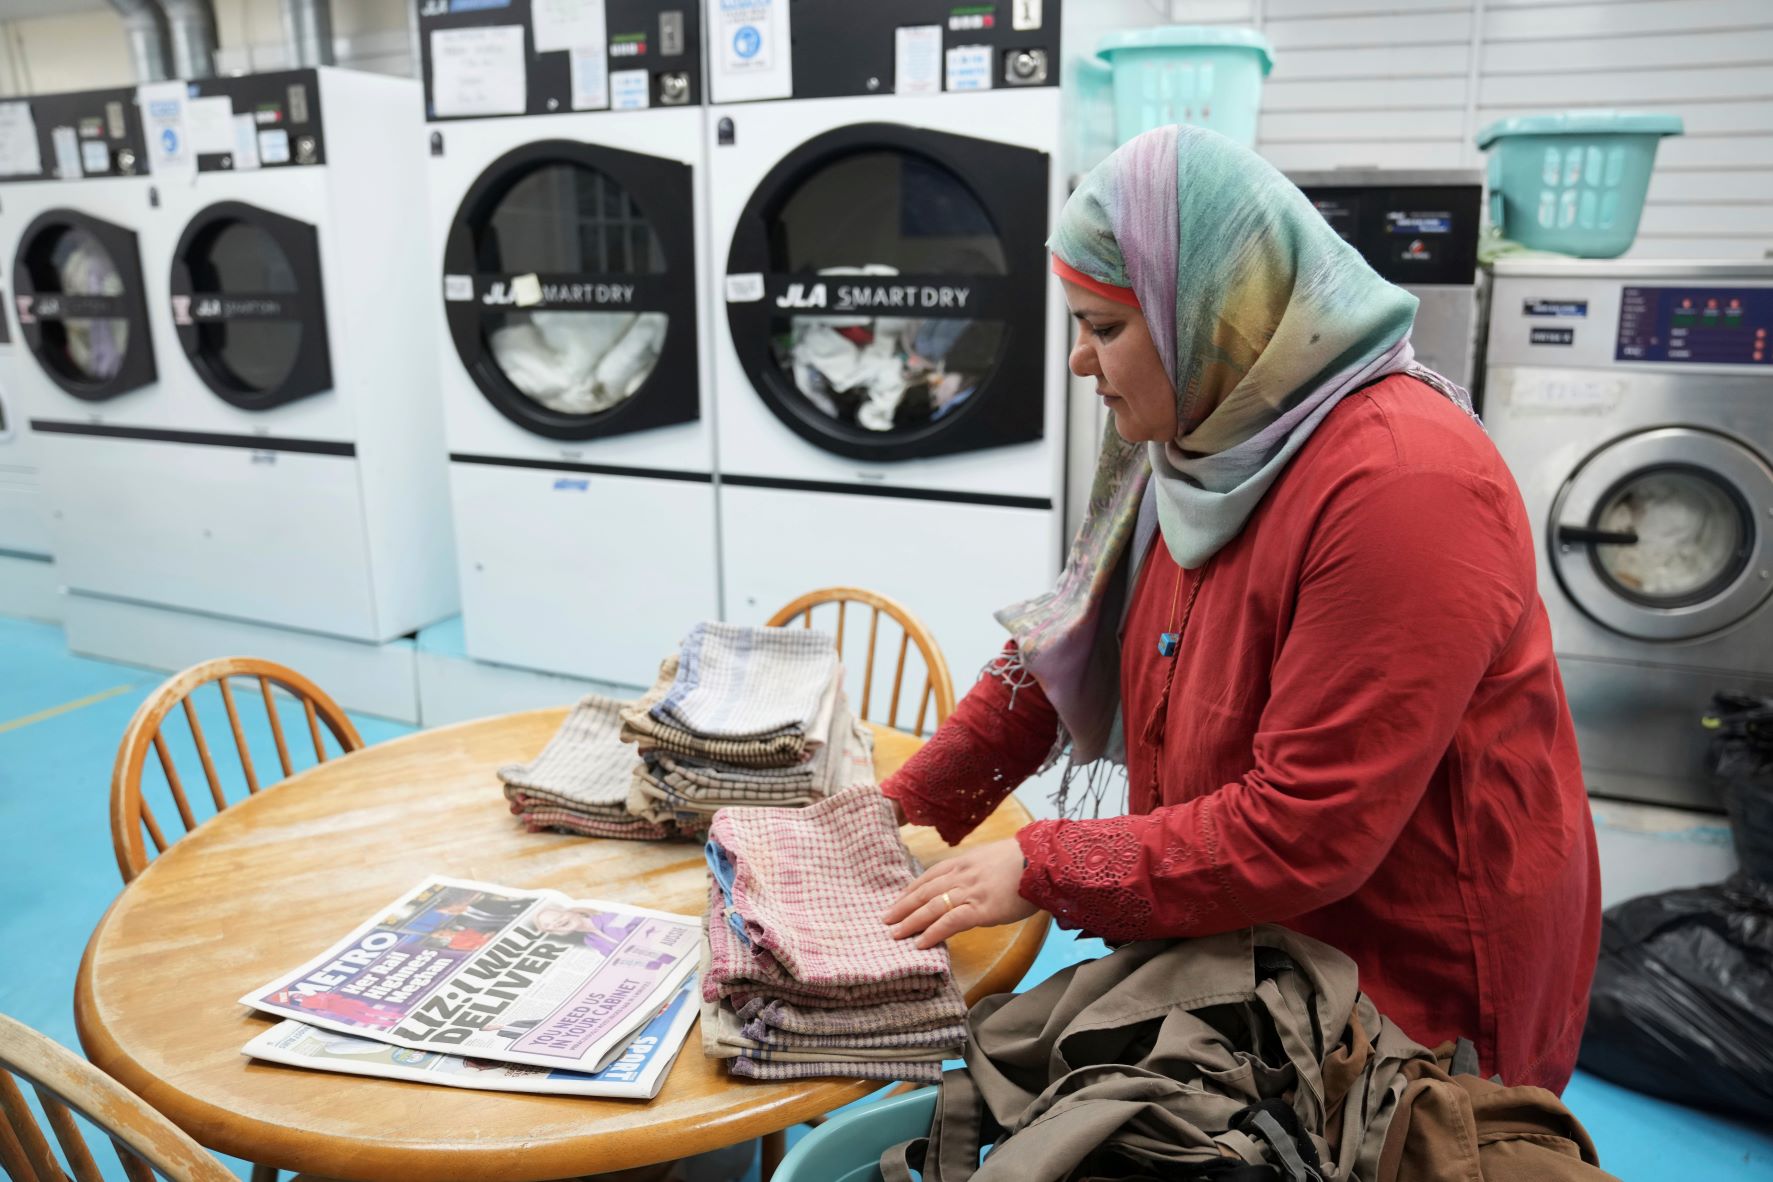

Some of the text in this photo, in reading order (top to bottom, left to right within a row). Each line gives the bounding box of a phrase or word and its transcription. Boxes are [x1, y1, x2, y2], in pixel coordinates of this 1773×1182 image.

[776, 282, 827, 309] JLA
[289, 931, 399, 1001] METRO
[341, 951, 411, 996] Her Rail
[362, 949, 439, 1000] Highness
[463, 926, 549, 981] WILL
[384, 958, 455, 1004] Meghan
[427, 940, 572, 1045] DELIVER
[528, 992, 606, 1046] YOU NEED US
[548, 978, 641, 1049] IN YOUR CABINET
[604, 1035, 659, 1081] SPORT
